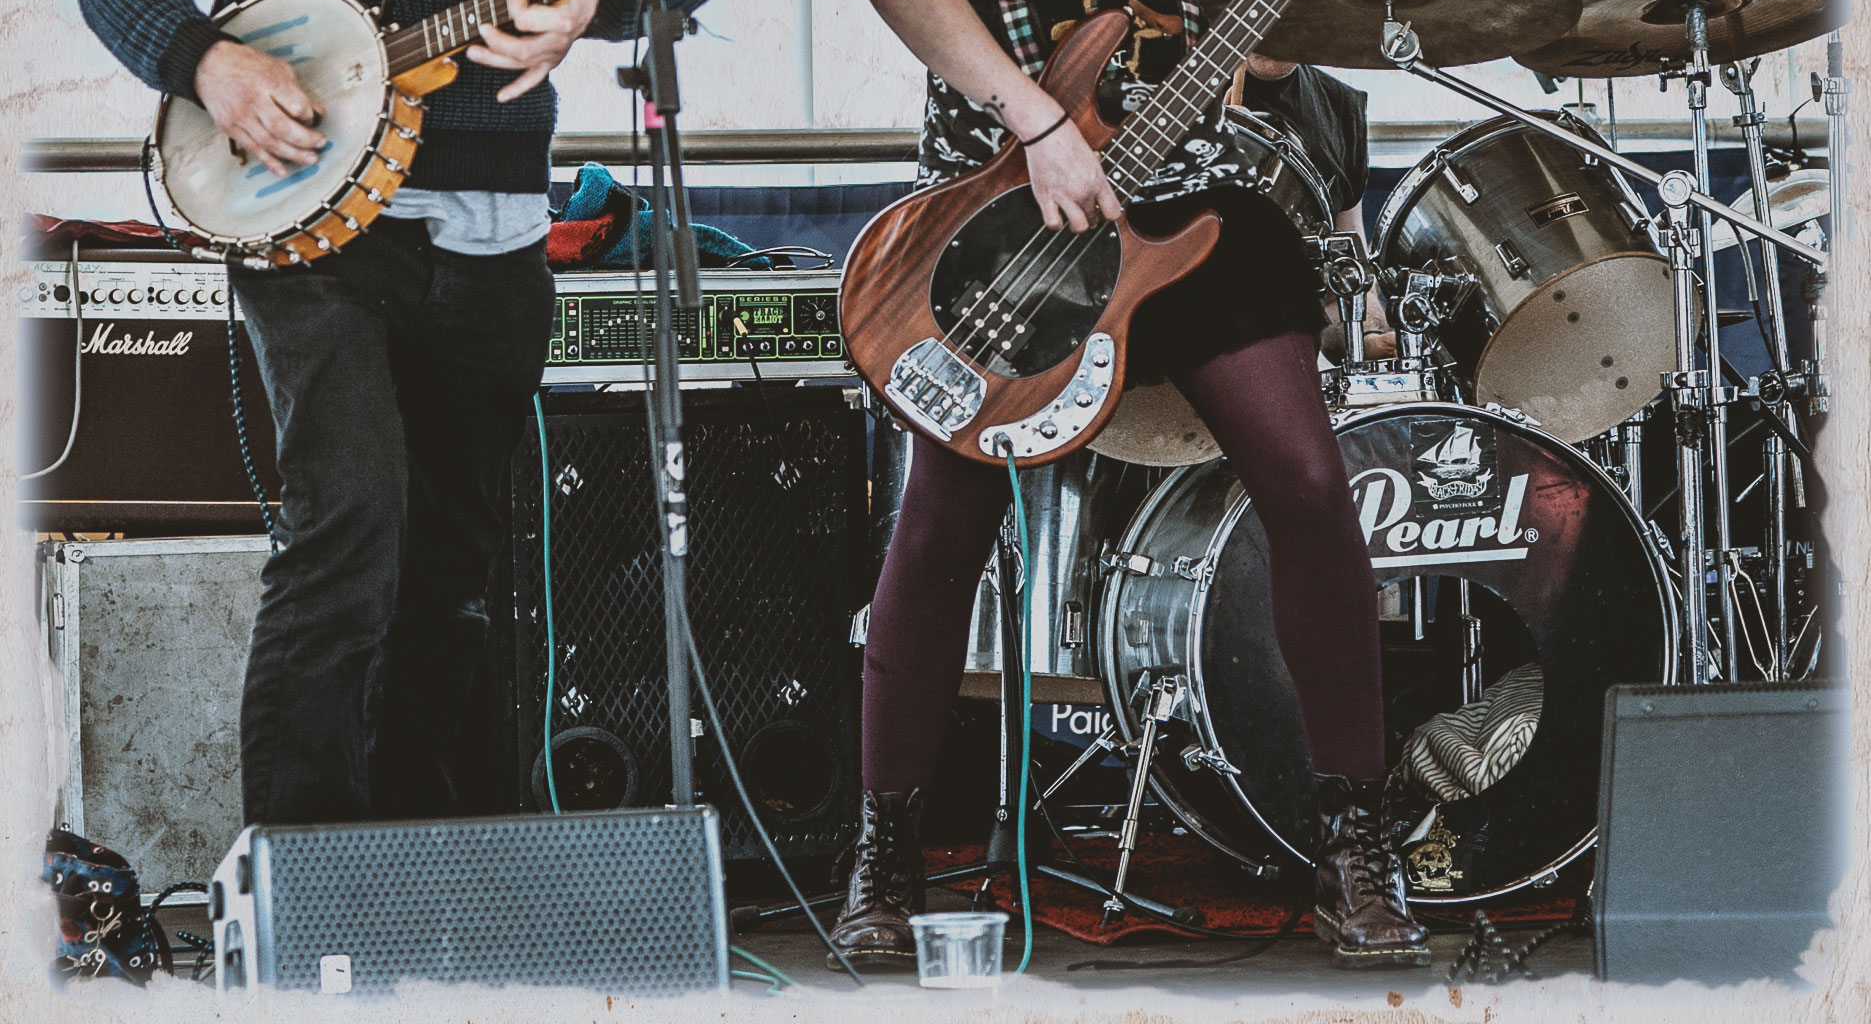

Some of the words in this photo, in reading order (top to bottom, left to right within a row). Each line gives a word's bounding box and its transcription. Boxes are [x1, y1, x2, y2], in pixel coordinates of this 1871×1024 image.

[753, 308, 783, 316] TRACE
[753, 315, 783, 324] ELLIOT
[81, 322, 194, 356] Marshall
[1348, 468, 1529, 553] Pearl
